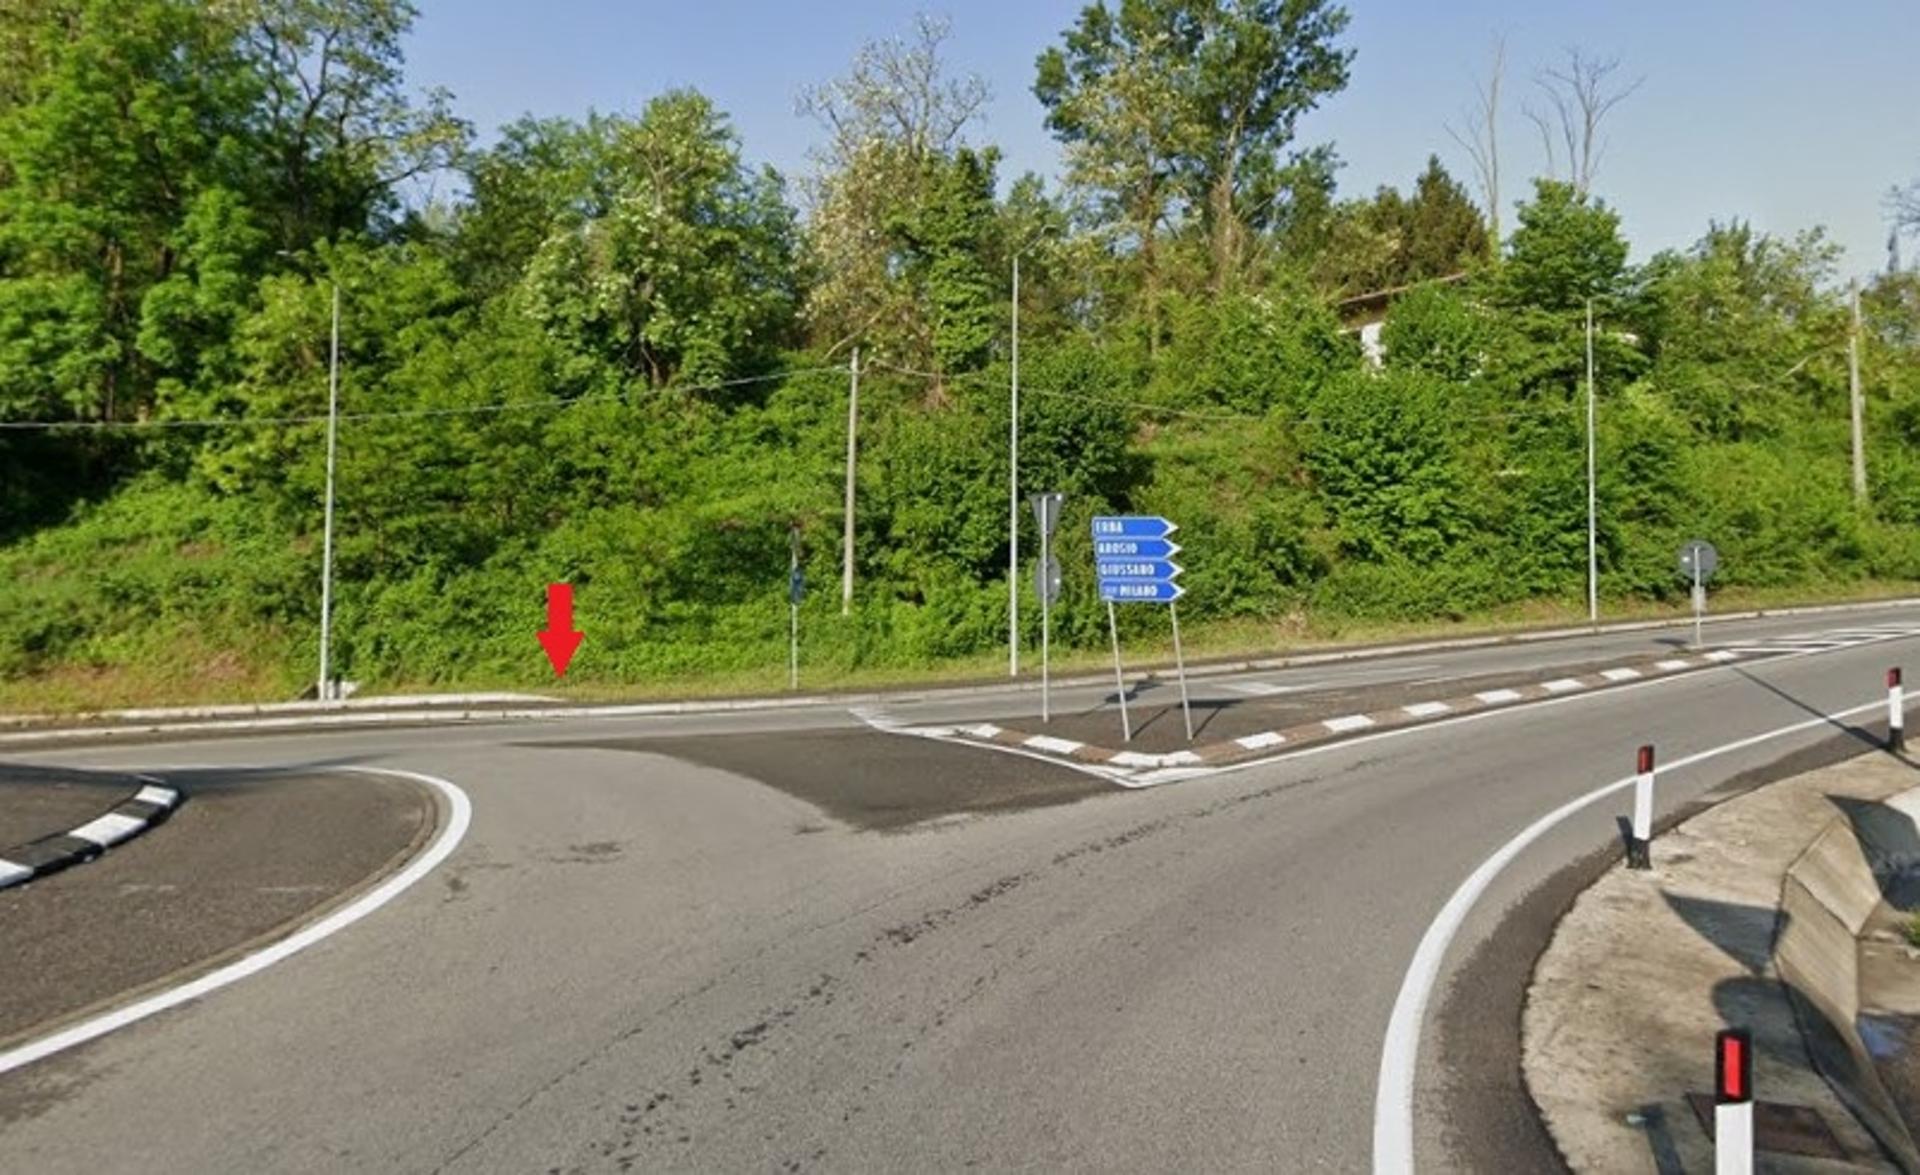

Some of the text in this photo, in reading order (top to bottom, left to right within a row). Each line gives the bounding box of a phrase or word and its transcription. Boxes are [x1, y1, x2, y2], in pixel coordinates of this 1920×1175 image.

[1098, 542, 1138, 554] AROSIO
[1100, 564, 1155, 575] GIUSSANO
[1120, 585, 1158, 596] MILANO
